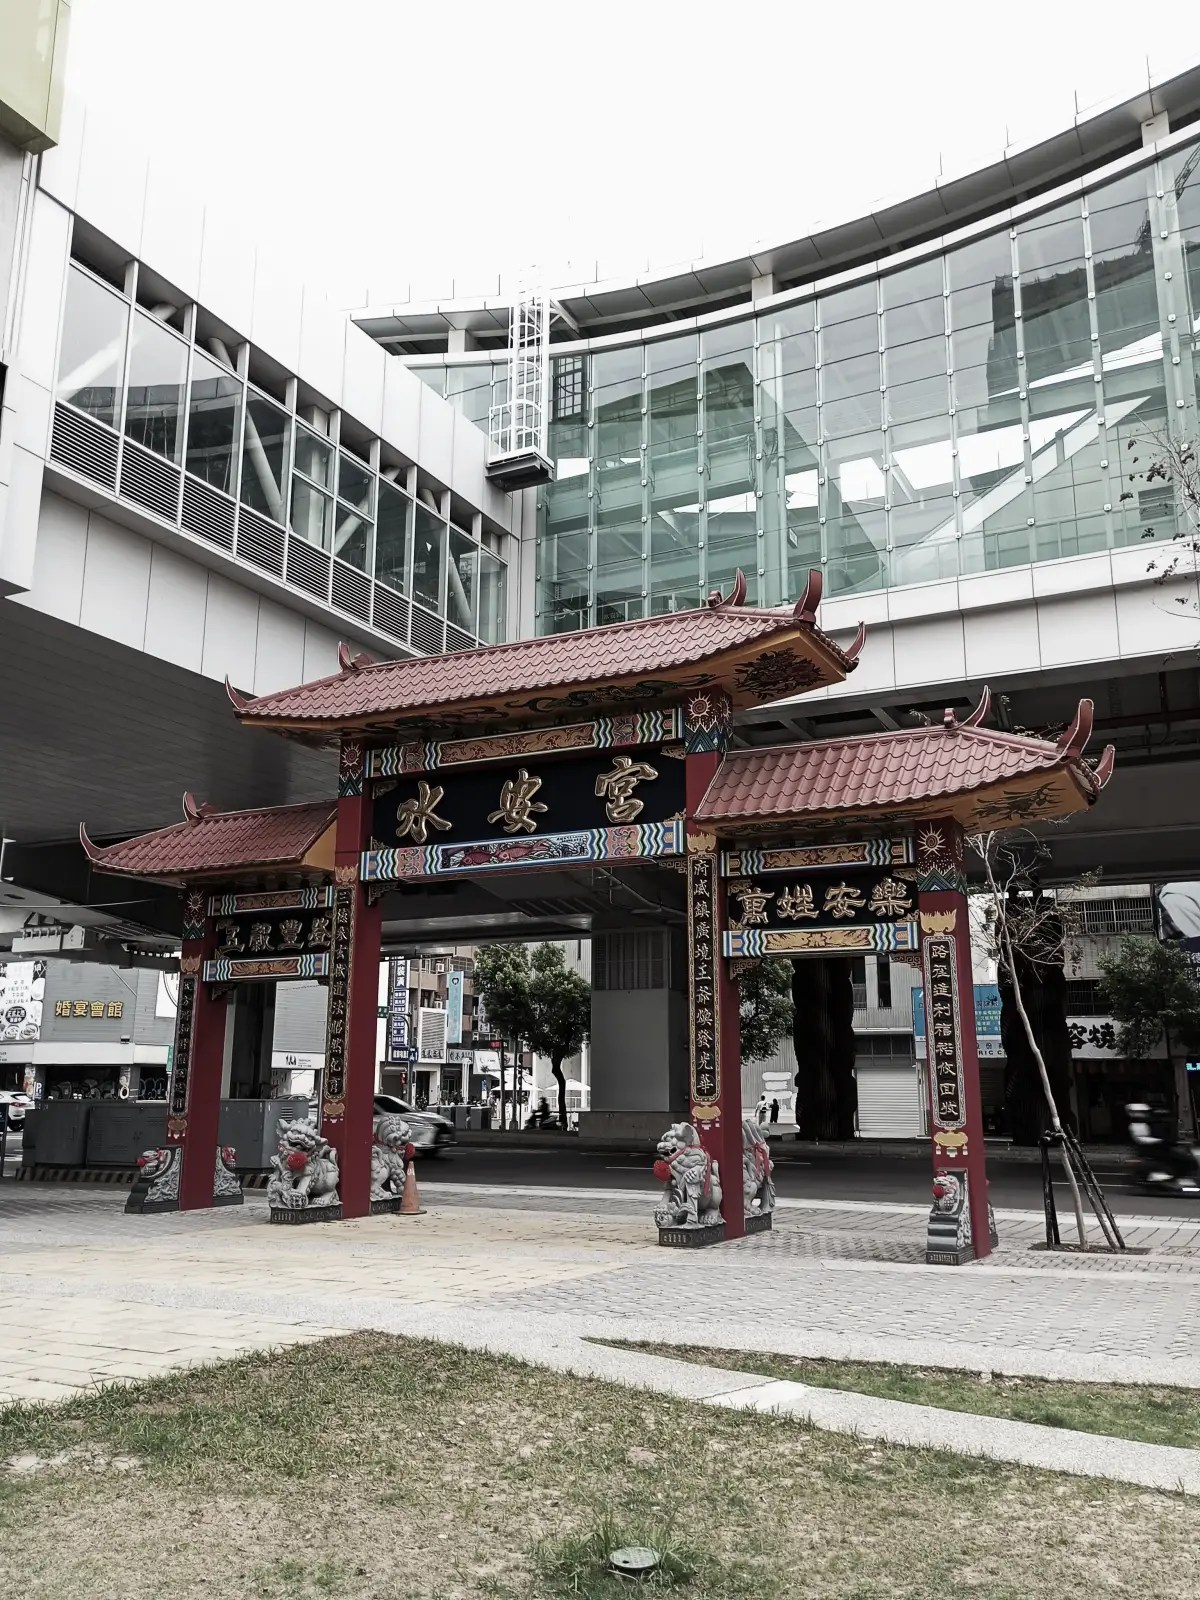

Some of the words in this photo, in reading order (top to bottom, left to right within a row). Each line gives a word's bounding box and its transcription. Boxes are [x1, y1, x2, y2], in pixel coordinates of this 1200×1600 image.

[395, 756, 660, 844] 水安宮
[736, 876, 913, 925] 萬姓安樂
[218, 917, 332, 953] 五穀豐登
[55, 1000, 124, 1018] 婚宴會館
